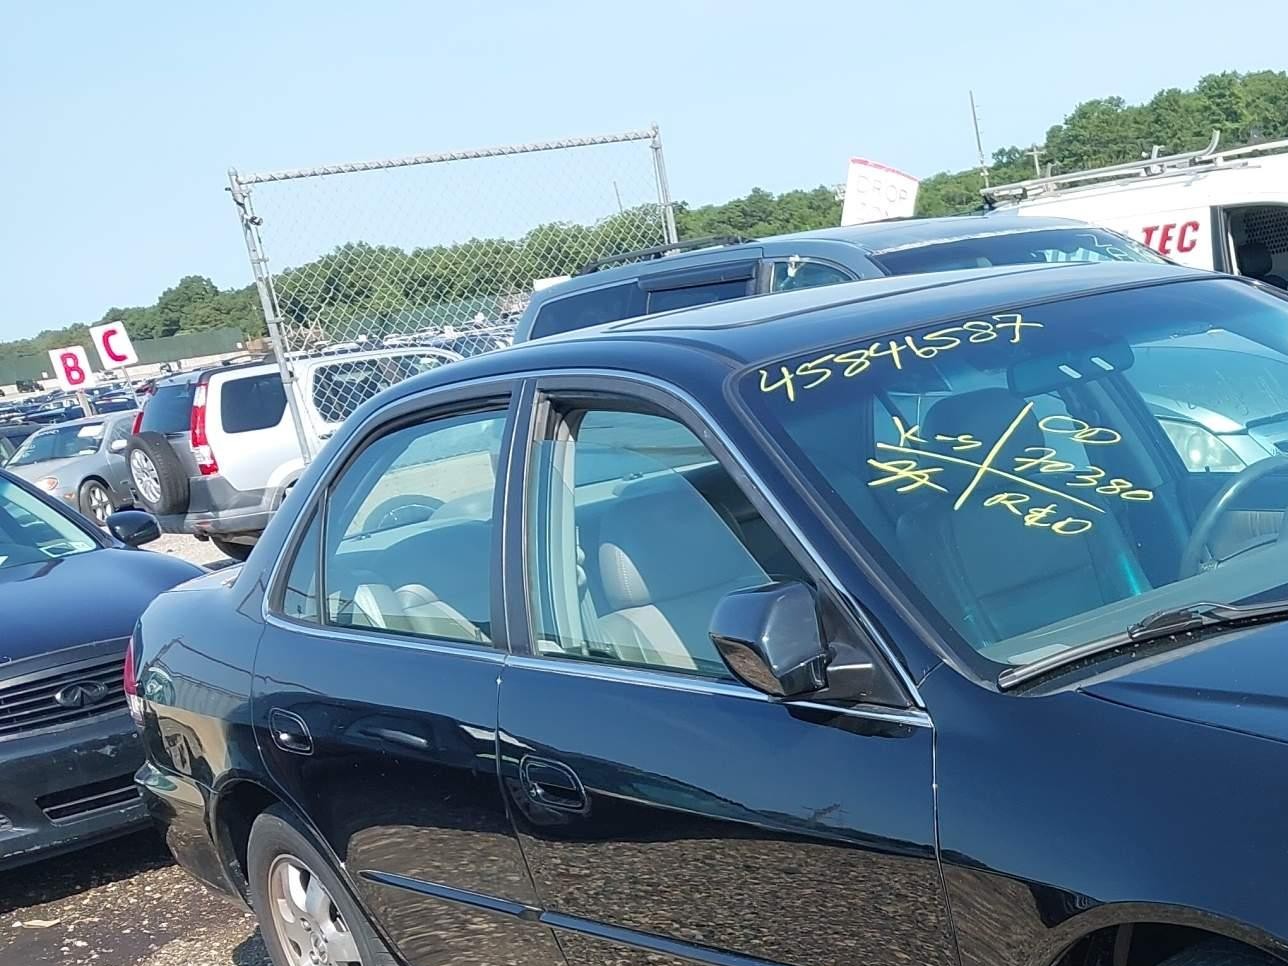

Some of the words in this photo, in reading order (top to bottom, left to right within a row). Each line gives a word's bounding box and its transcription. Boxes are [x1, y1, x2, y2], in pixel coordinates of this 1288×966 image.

[1142, 220, 1199, 254] TEC
[102, 329, 127, 362] C
[758, 313, 1044, 401] 45846587
[60, 352, 85, 385] B
